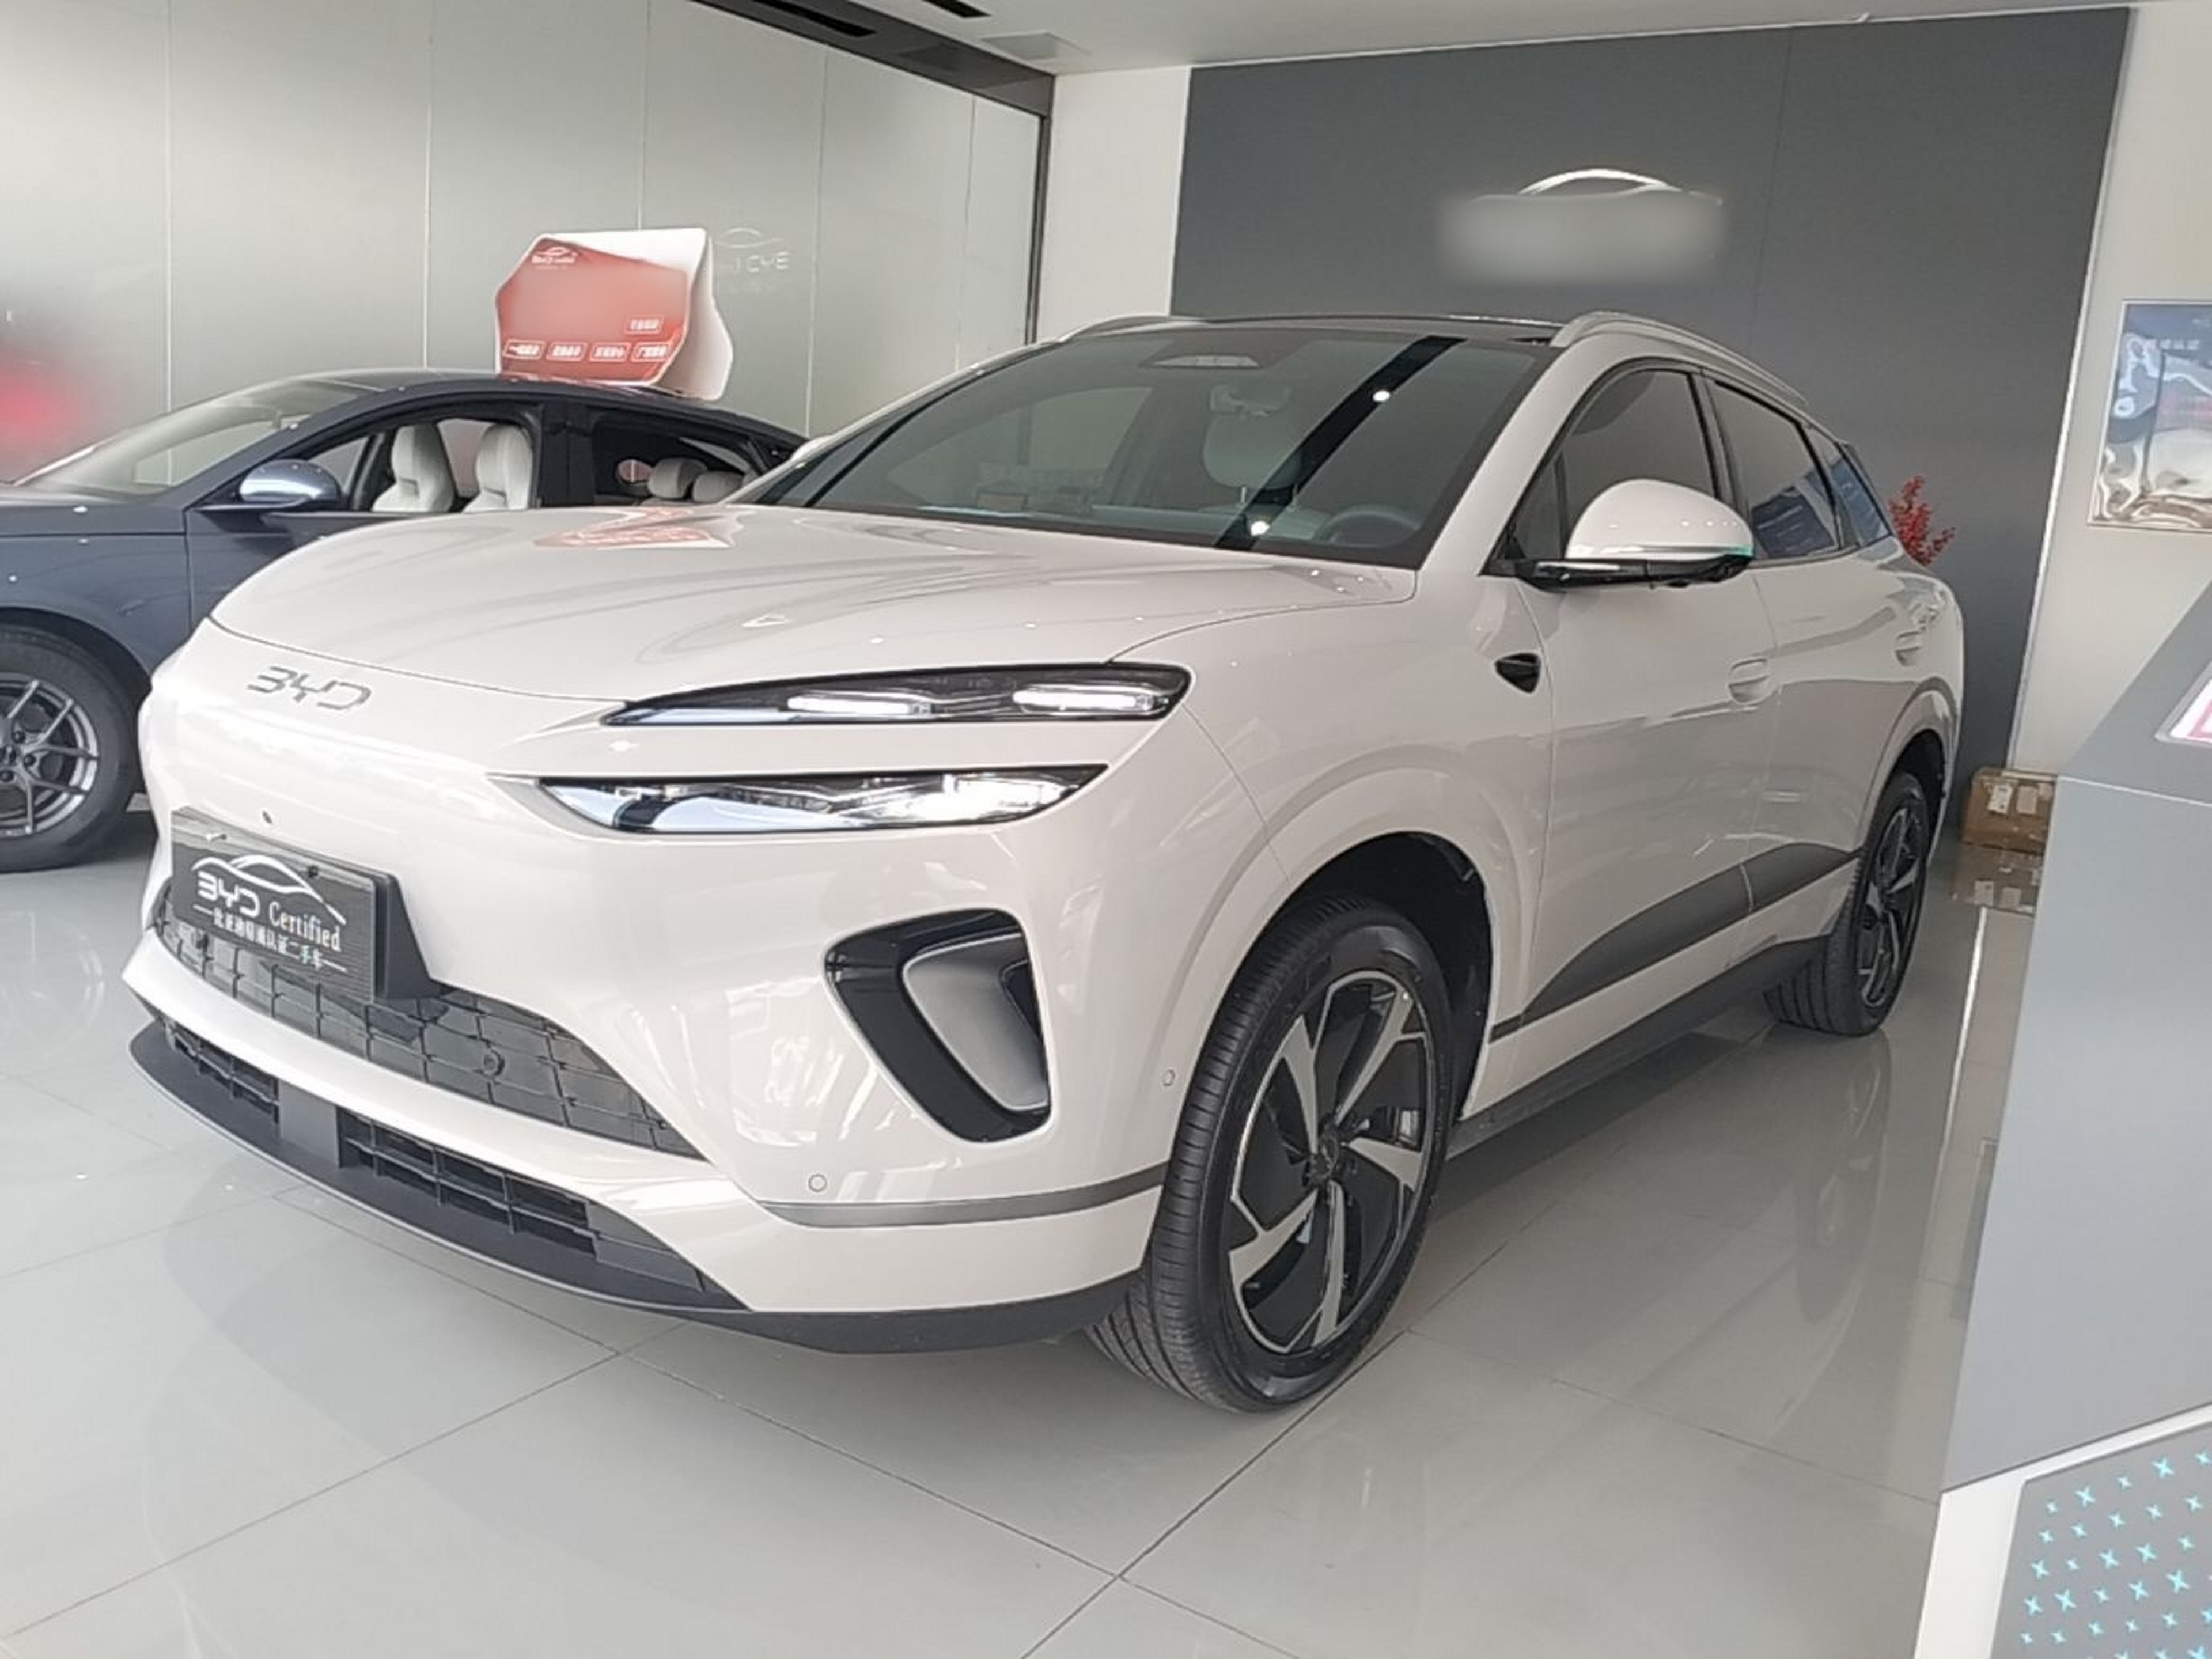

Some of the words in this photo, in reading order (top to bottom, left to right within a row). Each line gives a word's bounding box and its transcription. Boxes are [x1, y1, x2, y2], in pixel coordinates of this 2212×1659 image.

[246, 666, 372, 710] BYD
[198, 870, 261, 918] BYD
[268, 900, 342, 952] Certified
